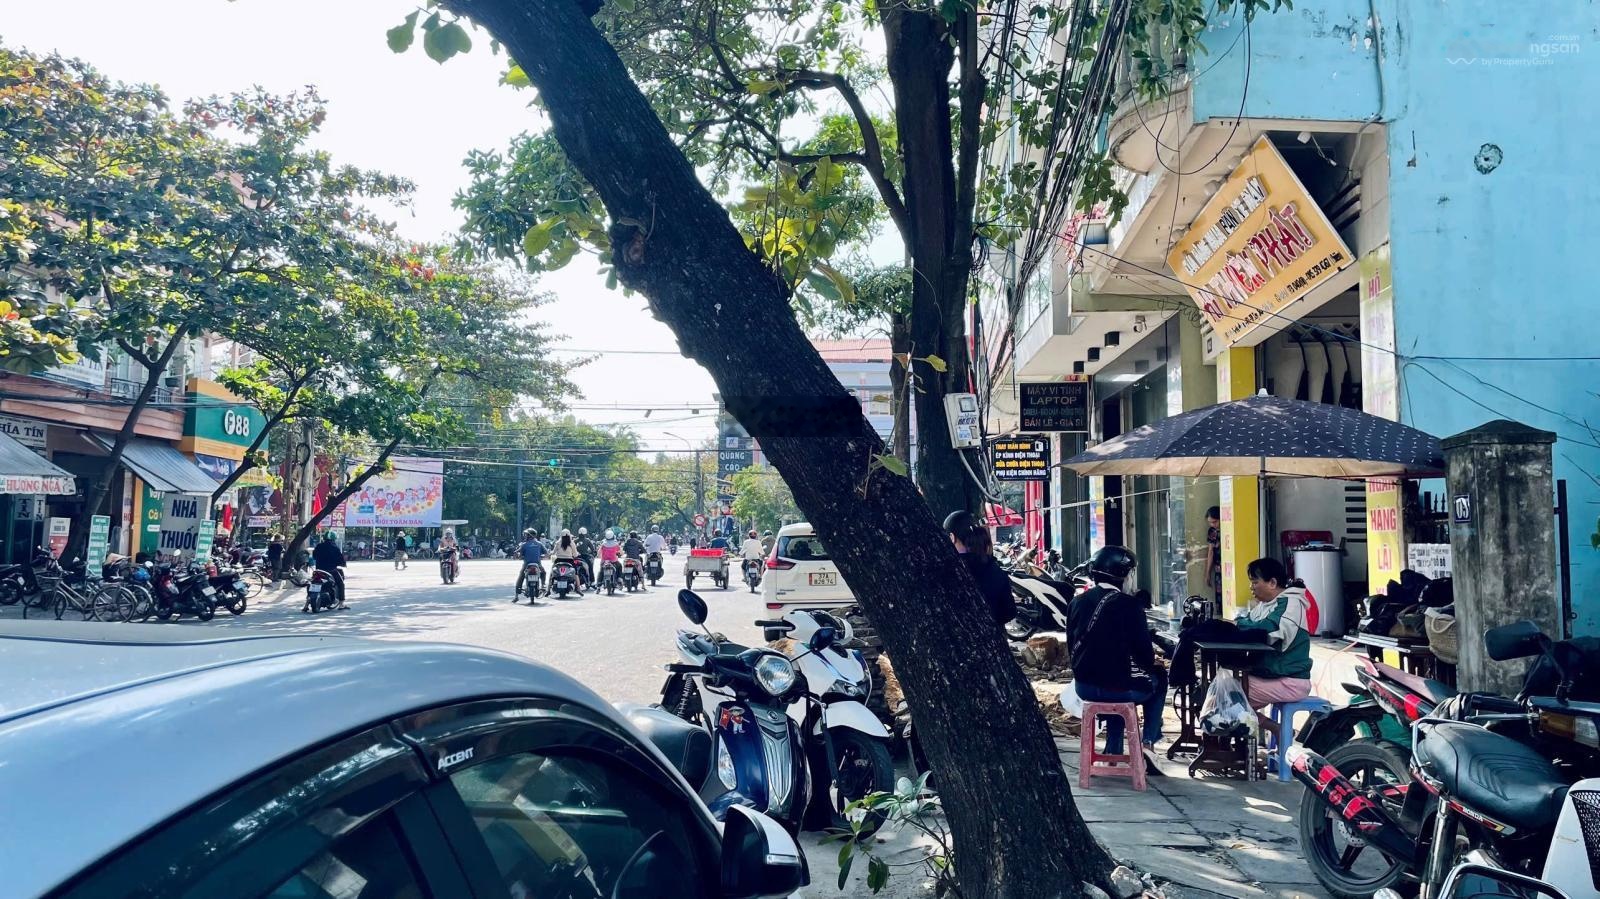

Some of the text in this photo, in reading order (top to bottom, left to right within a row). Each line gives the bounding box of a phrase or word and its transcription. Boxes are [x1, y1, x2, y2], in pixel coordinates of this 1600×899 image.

[1247, 203, 1314, 278] PHÁT
[1027, 384, 1047, 396] MÁY
[1030, 396, 1077, 405] LAPTOP
[224, 410, 250, 437] F88
[1024, 416, 1041, 427] BÁN
[23, 425, 44, 438] TÍN
[171, 496, 198, 519] NHÀ
[438, 747, 474, 770] ACCENT
